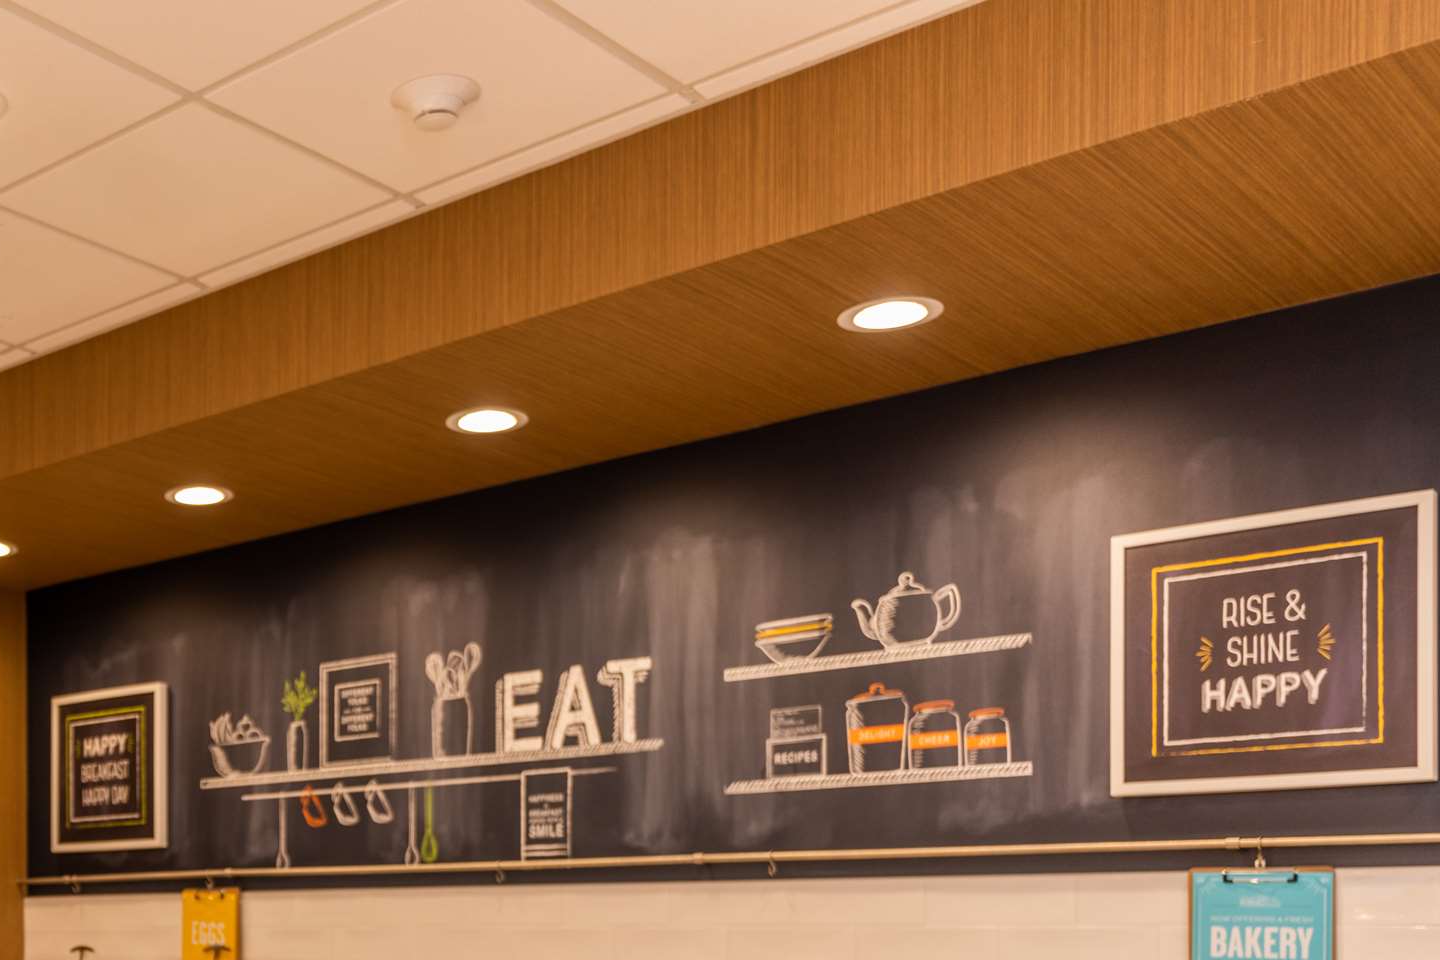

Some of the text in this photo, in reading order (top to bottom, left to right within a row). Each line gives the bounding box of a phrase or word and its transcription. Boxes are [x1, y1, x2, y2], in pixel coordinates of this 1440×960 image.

[1222, 589, 1306, 628] RISE &
[1226, 630, 1300, 667] SHINE
[495, 656, 652, 752] EAT
[1201, 668, 1328, 713] HAPPY
[83, 734, 128, 757] HAPPY
[773, 750, 819, 765] RECIPES
[979, 736, 997, 746] JOY
[528, 822, 565, 839] SMILE
[1210, 927, 1313, 960] BAKERY
